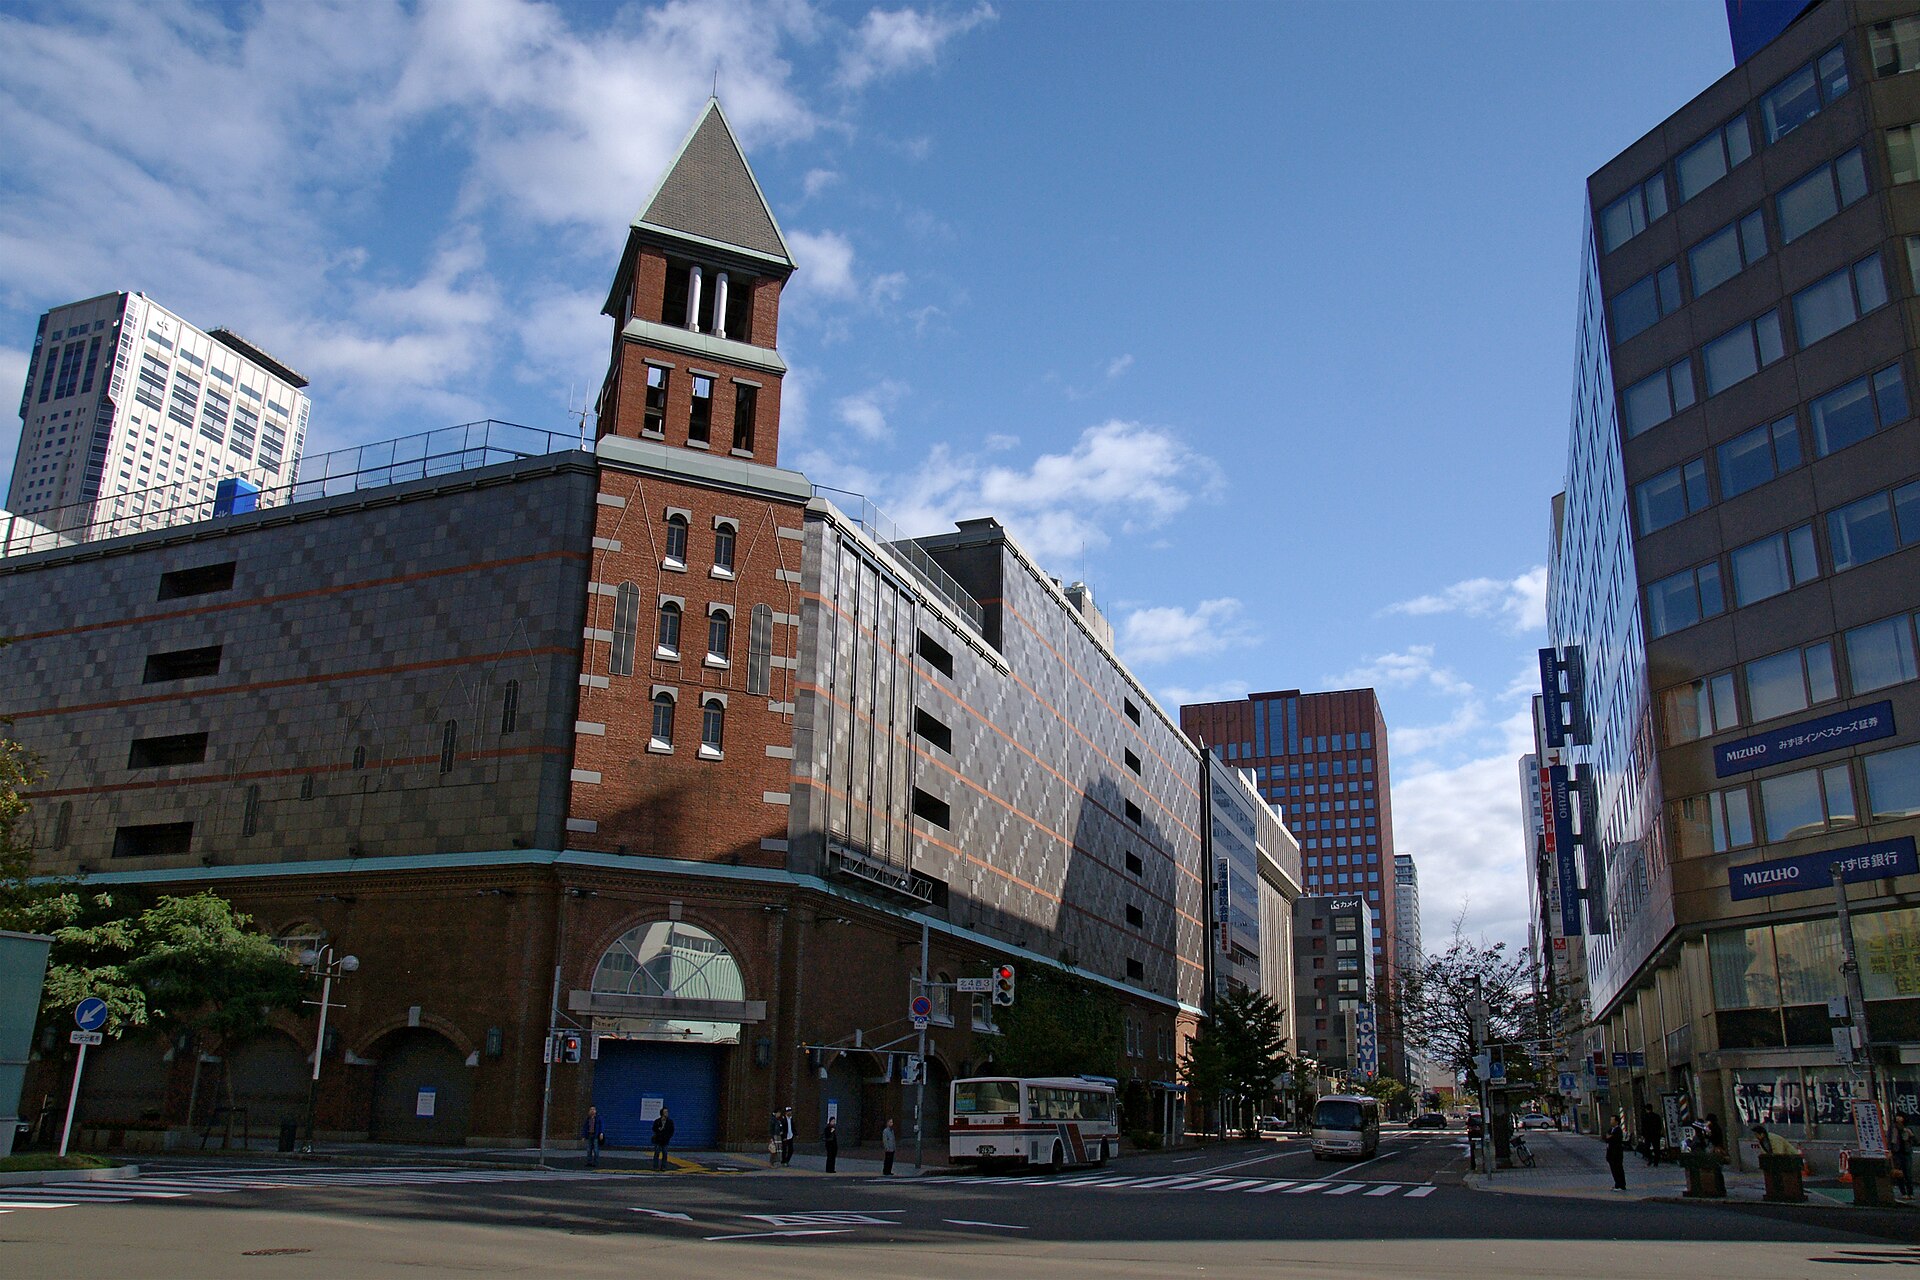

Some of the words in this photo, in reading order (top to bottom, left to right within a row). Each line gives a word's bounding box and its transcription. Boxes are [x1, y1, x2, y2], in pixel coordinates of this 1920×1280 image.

[1546, 656, 1554, 682] MIZUHO
[1778, 716, 1879, 750] みずほインベスターズ証券
[1726, 744, 1767, 762] MIZUHO
[1557, 781, 1568, 819] MIZUHO
[1562, 856, 1575, 922] みずほコーポレート銀行
[1743, 866, 1800, 886] MIZUHO
[1340, 900, 1359, 909] カメイ
[960, 979, 990, 987] 北4西3
[1358, 1007, 1375, 1073] TOKYU
